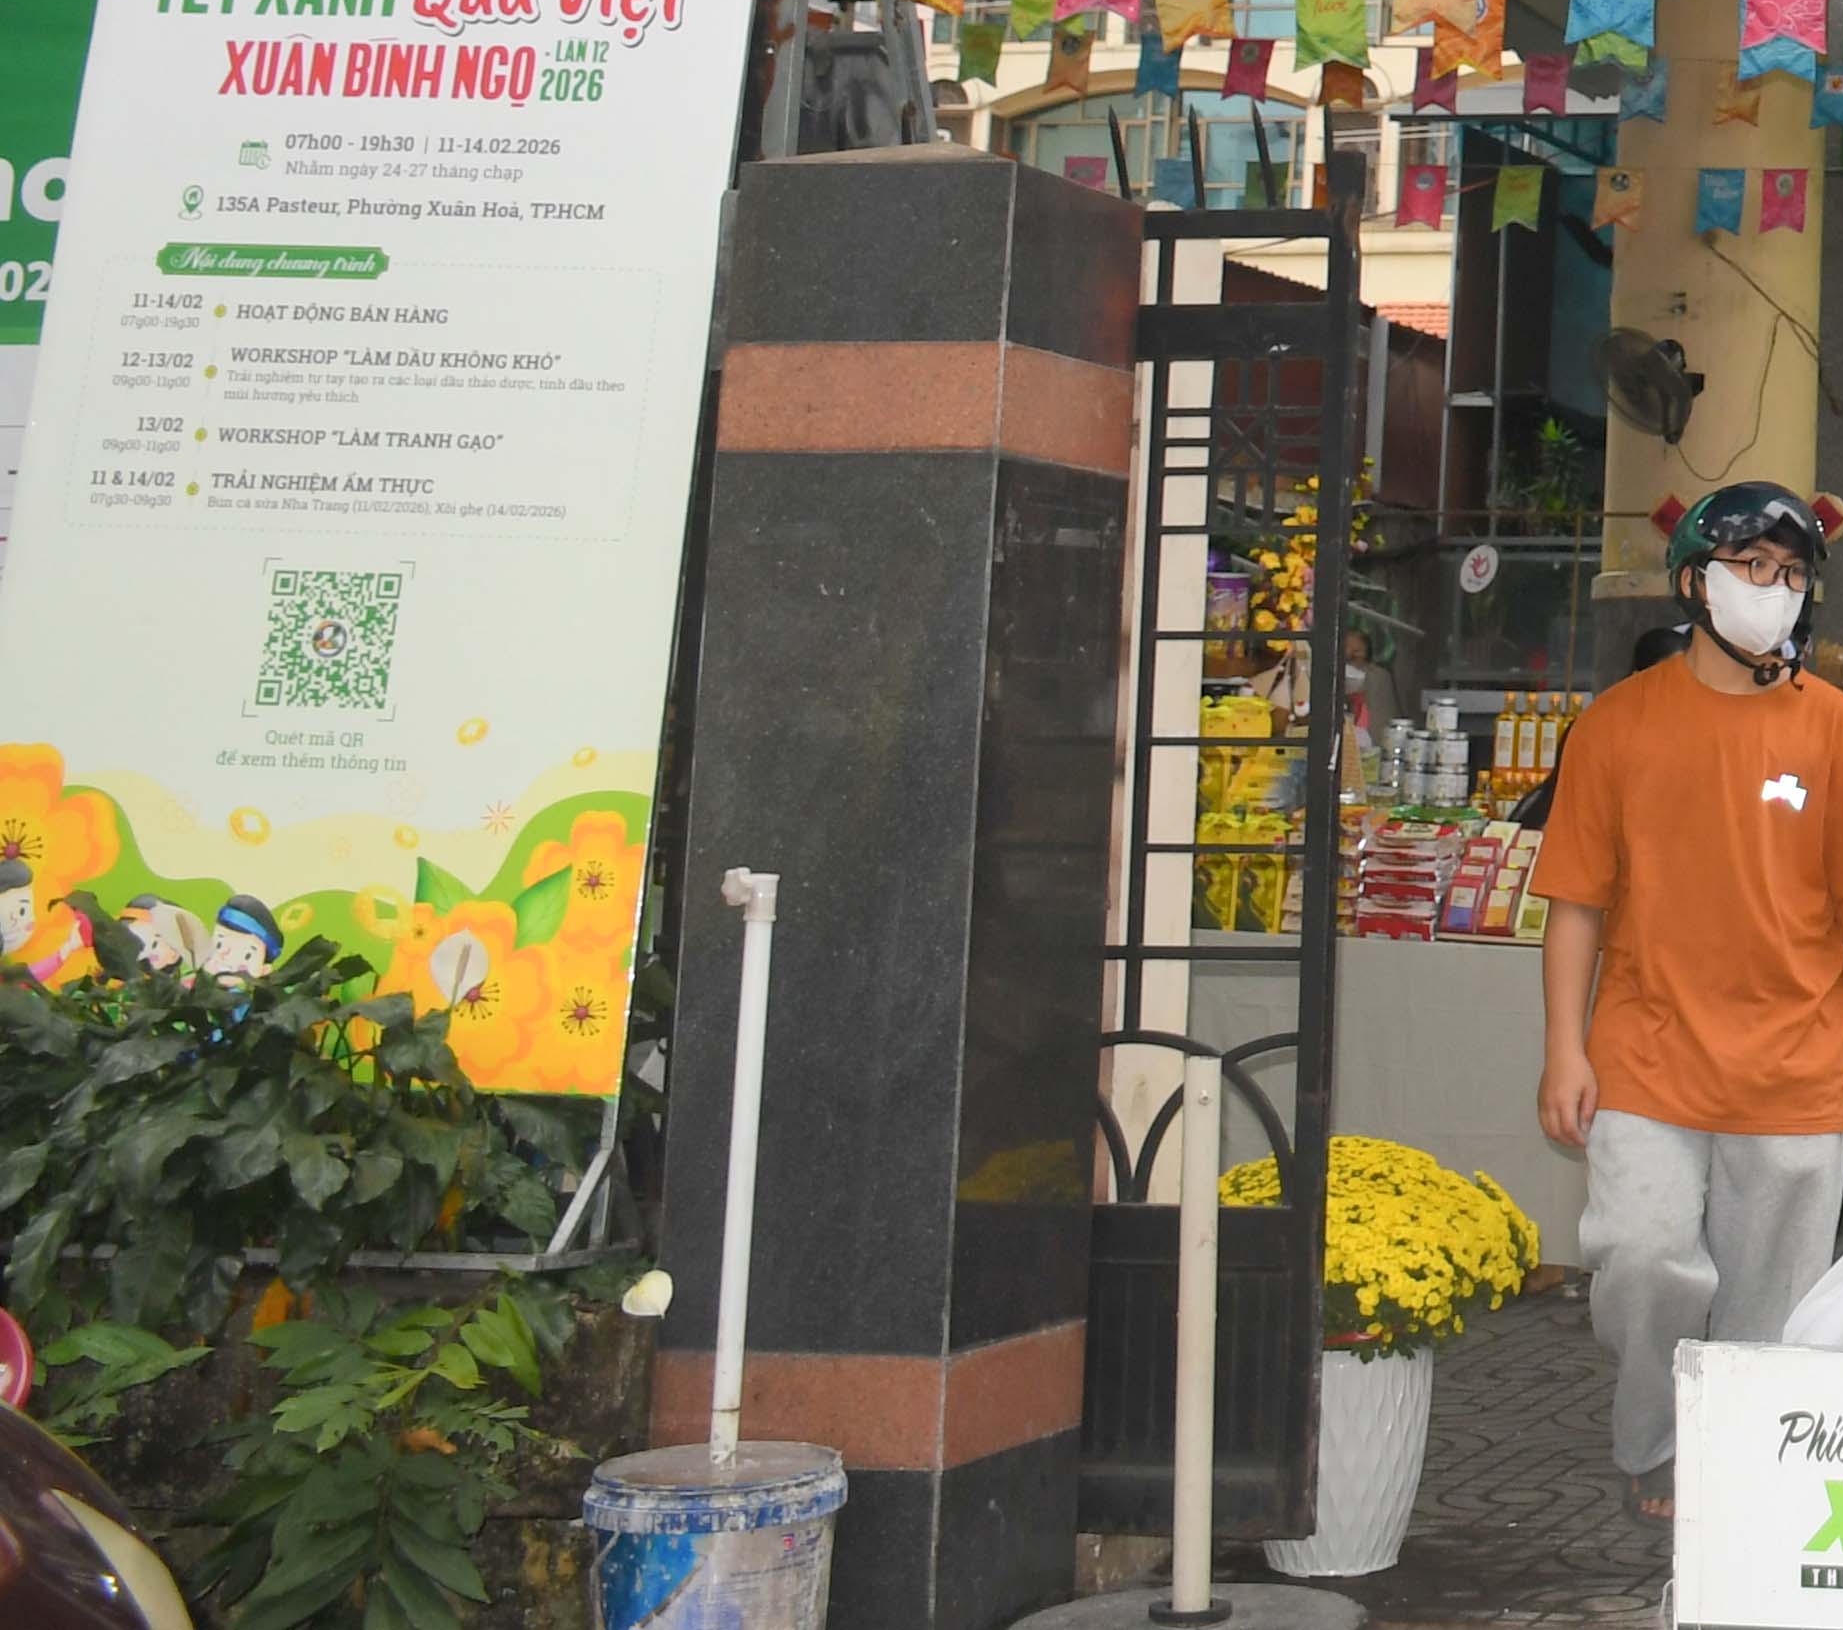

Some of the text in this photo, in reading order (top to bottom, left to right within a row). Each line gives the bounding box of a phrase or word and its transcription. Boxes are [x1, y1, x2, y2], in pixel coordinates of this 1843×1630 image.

[217, 33, 339, 97] XUÂN
[450, 43, 537, 108] NGỌ
[539, 68, 605, 103] 2026
[382, 163, 427, 181] 24-27
[216, 195, 261, 215] 135A
[266, 196, 342, 218] Pasteur,
[347, 197, 422, 220] Phường
[426, 199, 478, 219] Xuân
[530, 203, 606, 221] TP.HCM
[132, 293, 449, 325] 11-14/02 HOẠT ĐỘNG BÁN HÀNG
[121, 352, 194, 368] 12-13/02
[231, 347, 339, 366] WORKSHOP
[439, 350, 507, 371] KHÔNG
[137, 417, 184, 433] 13/02
[218, 427, 326, 445] WORKSHOP
[385, 431, 452, 450] TRANH
[91, 470, 107, 487] 11
[112, 472, 126, 487] &
[128, 471, 176, 487] 14/02
[260, 474, 337, 494] NGHIỆM
[240, 752, 276, 768] xem
